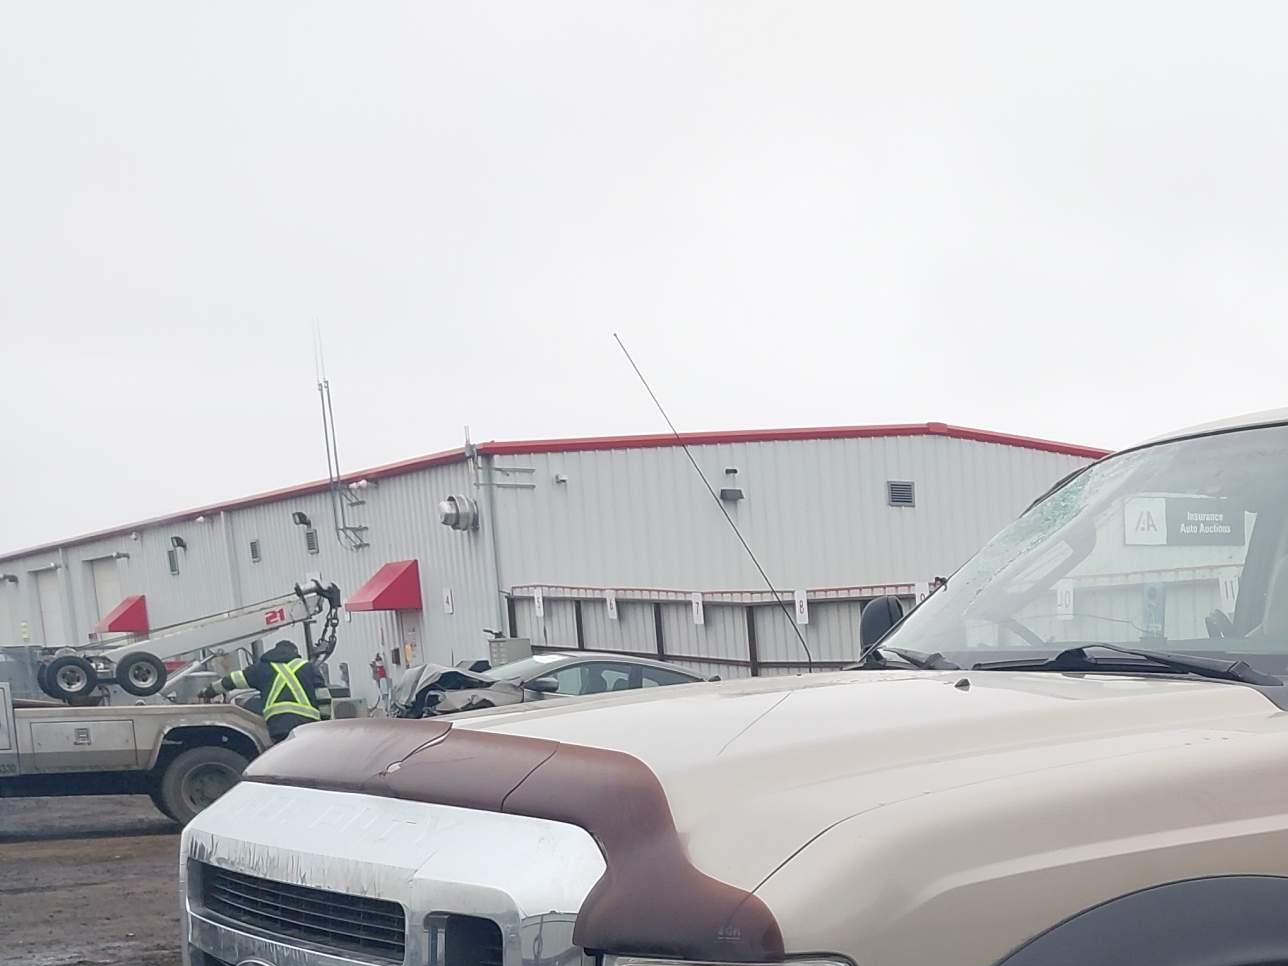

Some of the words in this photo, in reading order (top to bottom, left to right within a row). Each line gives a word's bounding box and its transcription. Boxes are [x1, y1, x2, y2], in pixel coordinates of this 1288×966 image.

[1187, 511, 1224, 521] Insurance
[1180, 523, 1198, 533] Auto
[1200, 523, 1232, 533] Auctions
[264, 608, 285, 625] 21
